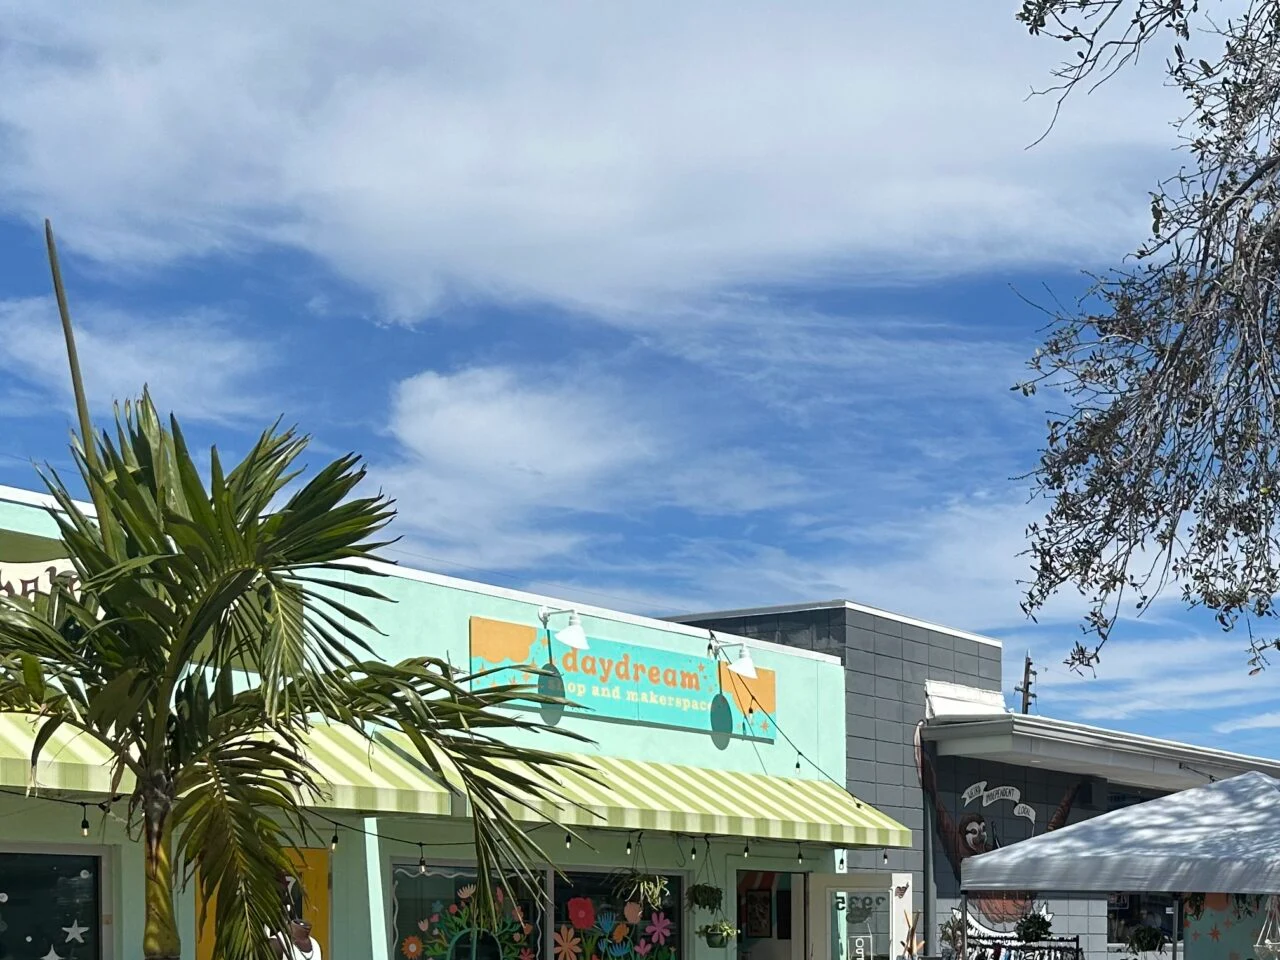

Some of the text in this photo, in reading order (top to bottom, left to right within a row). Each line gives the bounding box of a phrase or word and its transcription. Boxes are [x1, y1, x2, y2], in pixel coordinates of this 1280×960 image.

[562, 646, 701, 691] daydream
[591, 684, 622, 700] and
[985, 787, 1015, 803] INDEPENDENT
[1017, 805, 1032, 817] LOCAL
